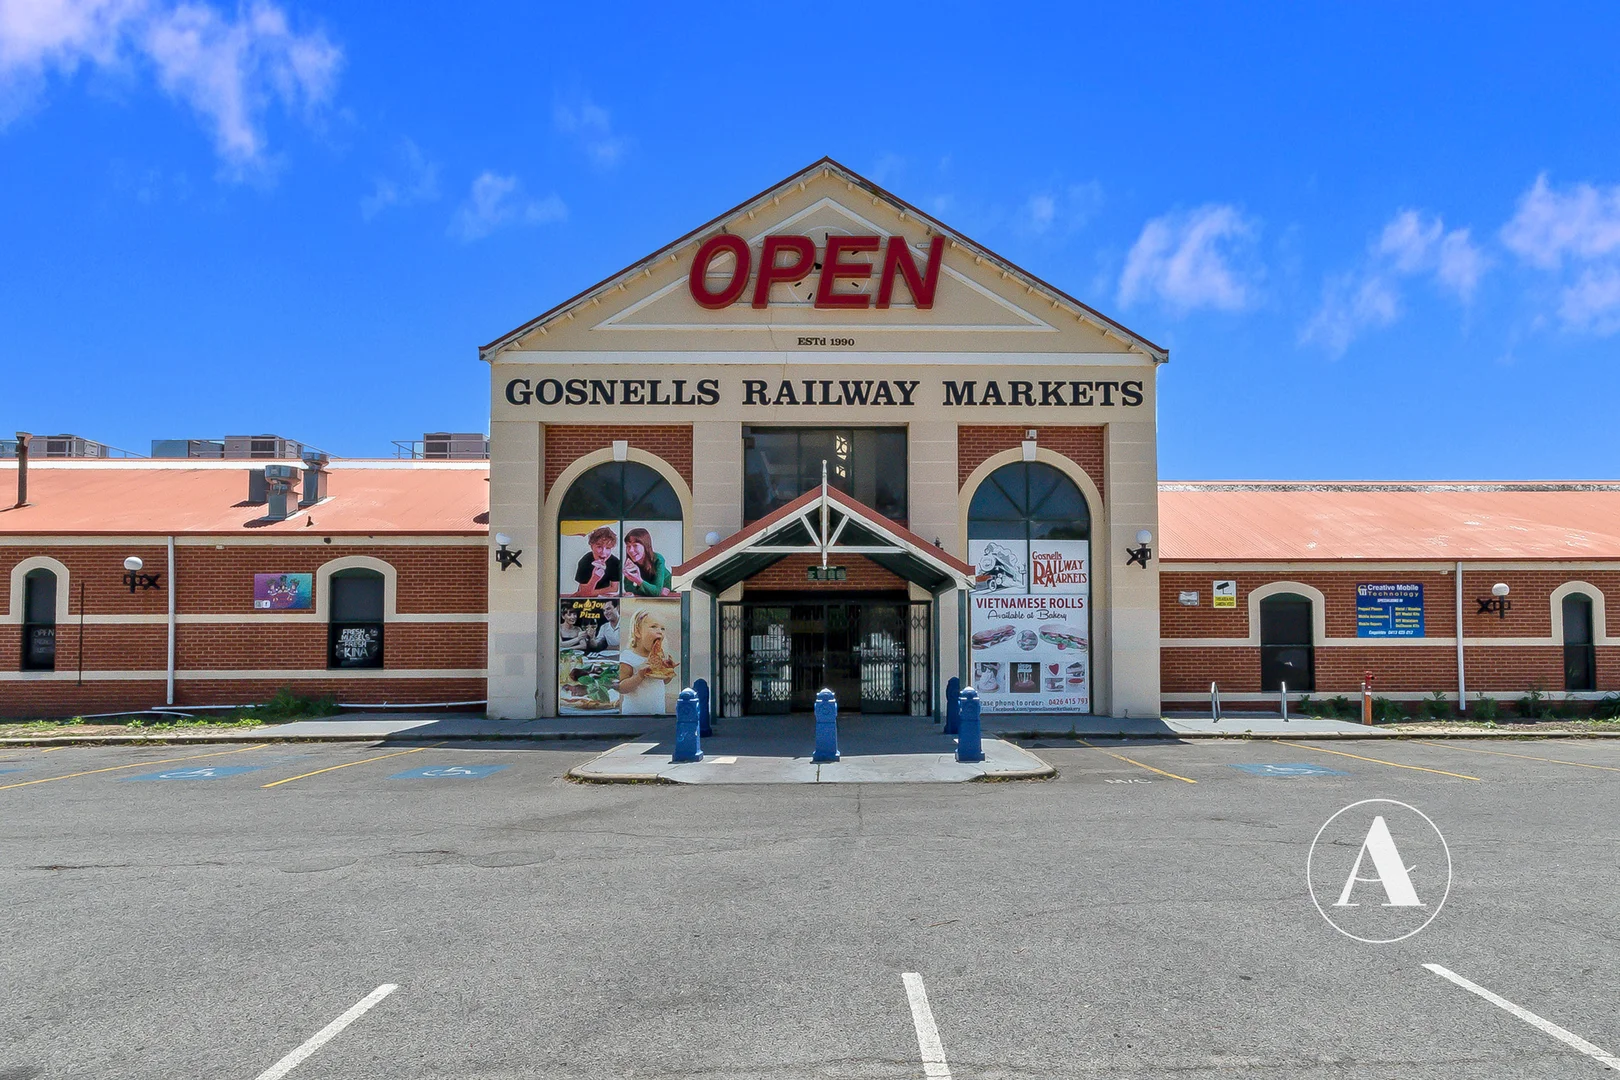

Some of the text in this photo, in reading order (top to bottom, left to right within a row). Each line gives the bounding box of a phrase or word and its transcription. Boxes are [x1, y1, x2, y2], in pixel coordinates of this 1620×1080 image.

[689, 234, 946, 309] OPEN
[797, 337, 855, 346] ESTd 1990
[505, 378, 1144, 406] GOSNELLS RAILWAY MARKETS
[1032, 551, 1063, 560] Gosnells
[1032, 560, 1084, 585] RAILWAY
[1044, 573, 1088, 587] MARKETS
[976, 598, 1084, 608] VIETNAMESE ROLLS
[988, 609, 1025, 620] Available
[1037, 609, 1067, 621] Bakery
[34, 629, 55, 637] OPEN
[344, 648, 368, 657] KINA
